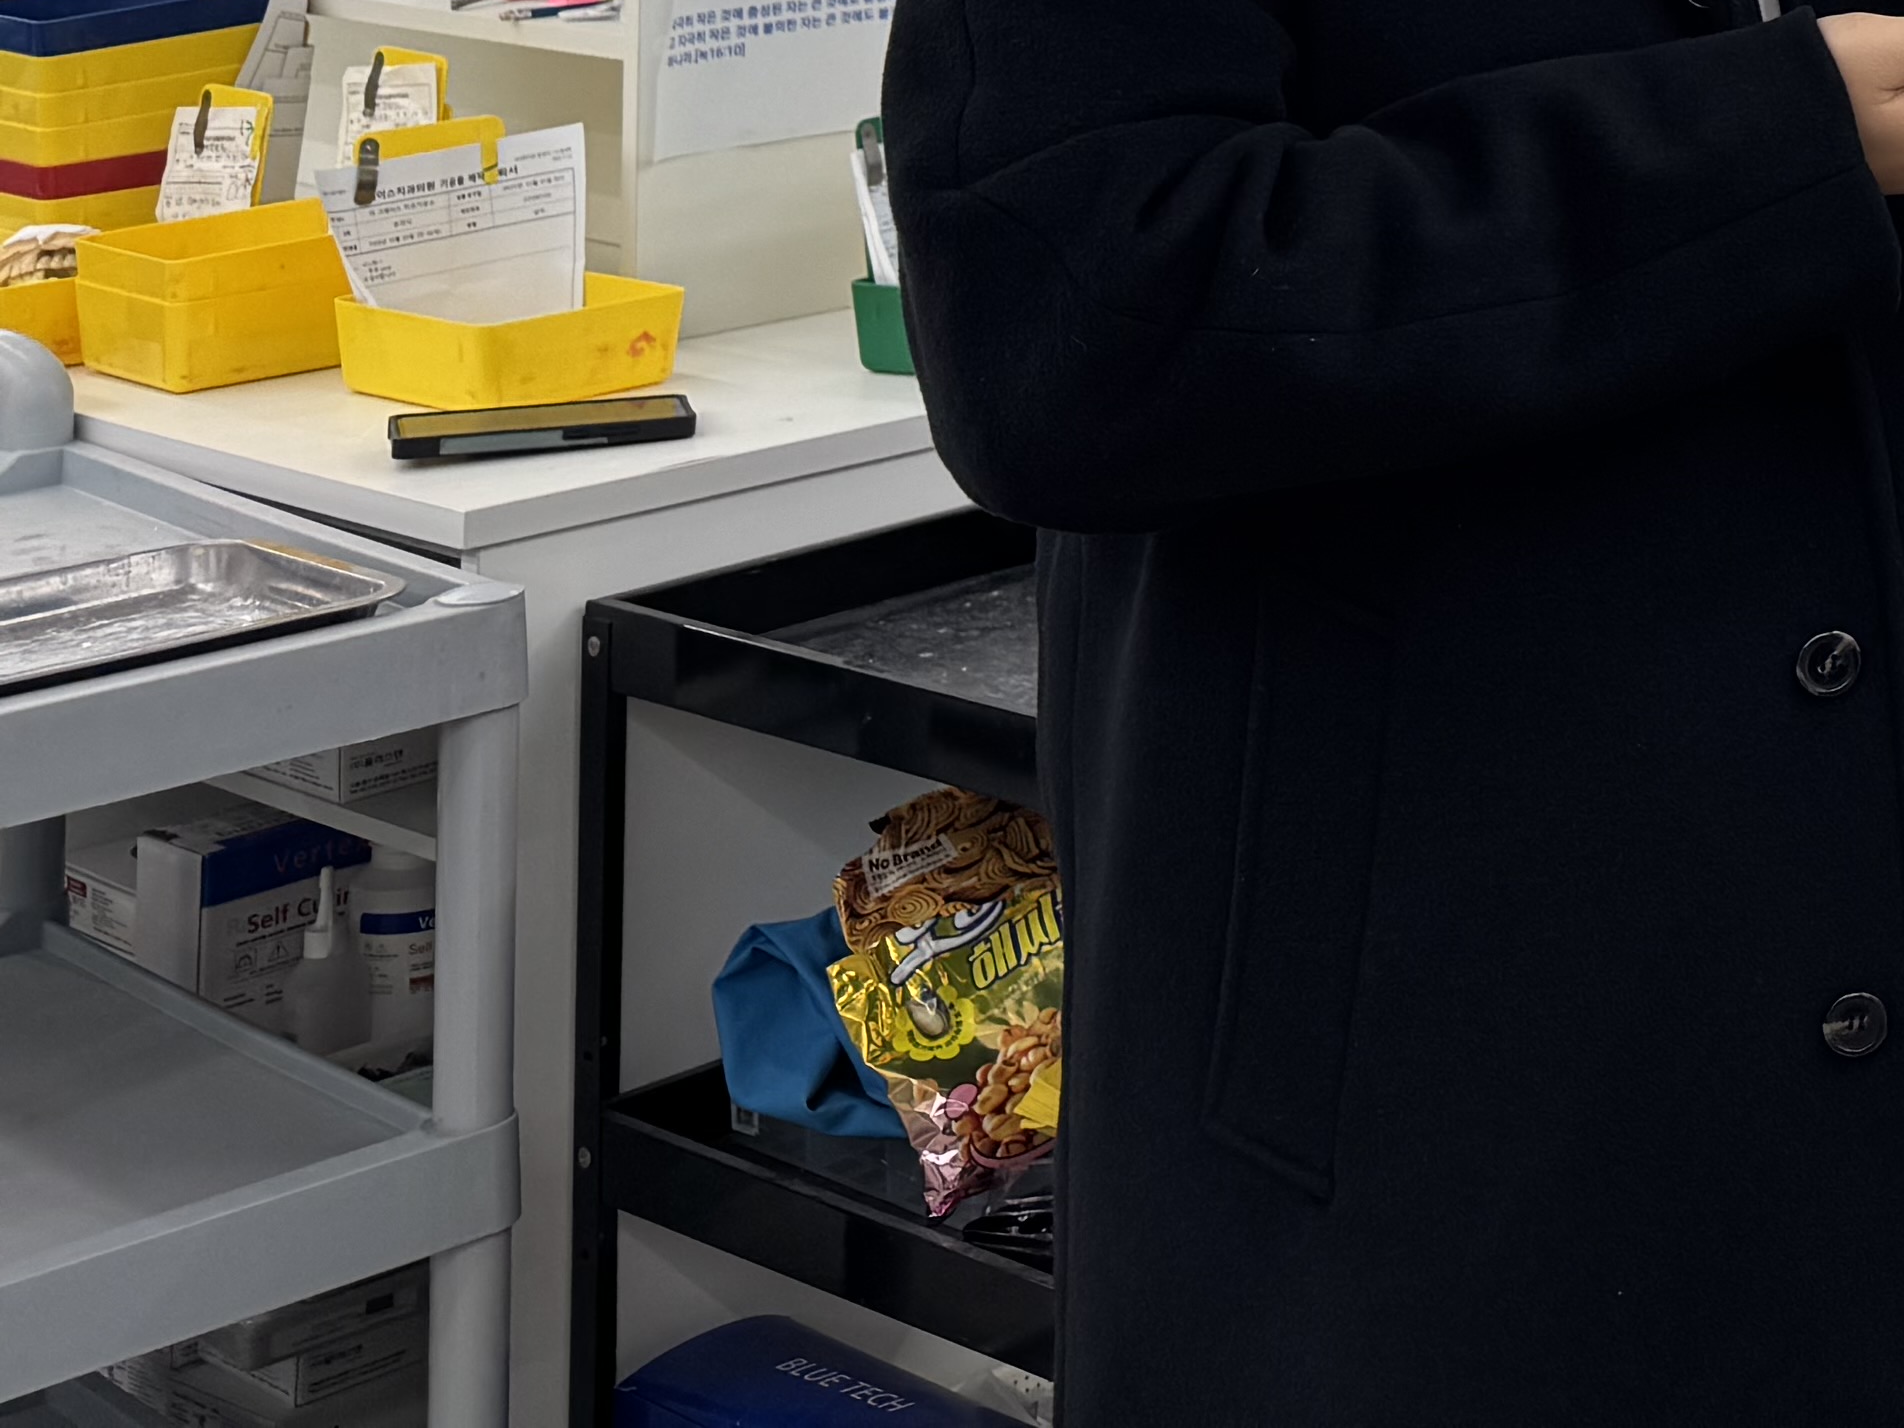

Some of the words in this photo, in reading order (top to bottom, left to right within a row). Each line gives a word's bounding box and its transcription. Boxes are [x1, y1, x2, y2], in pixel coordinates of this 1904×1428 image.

[868, 853, 890, 874] No
[891, 838, 945, 868] Brand
[246, 903, 290, 934] Self
